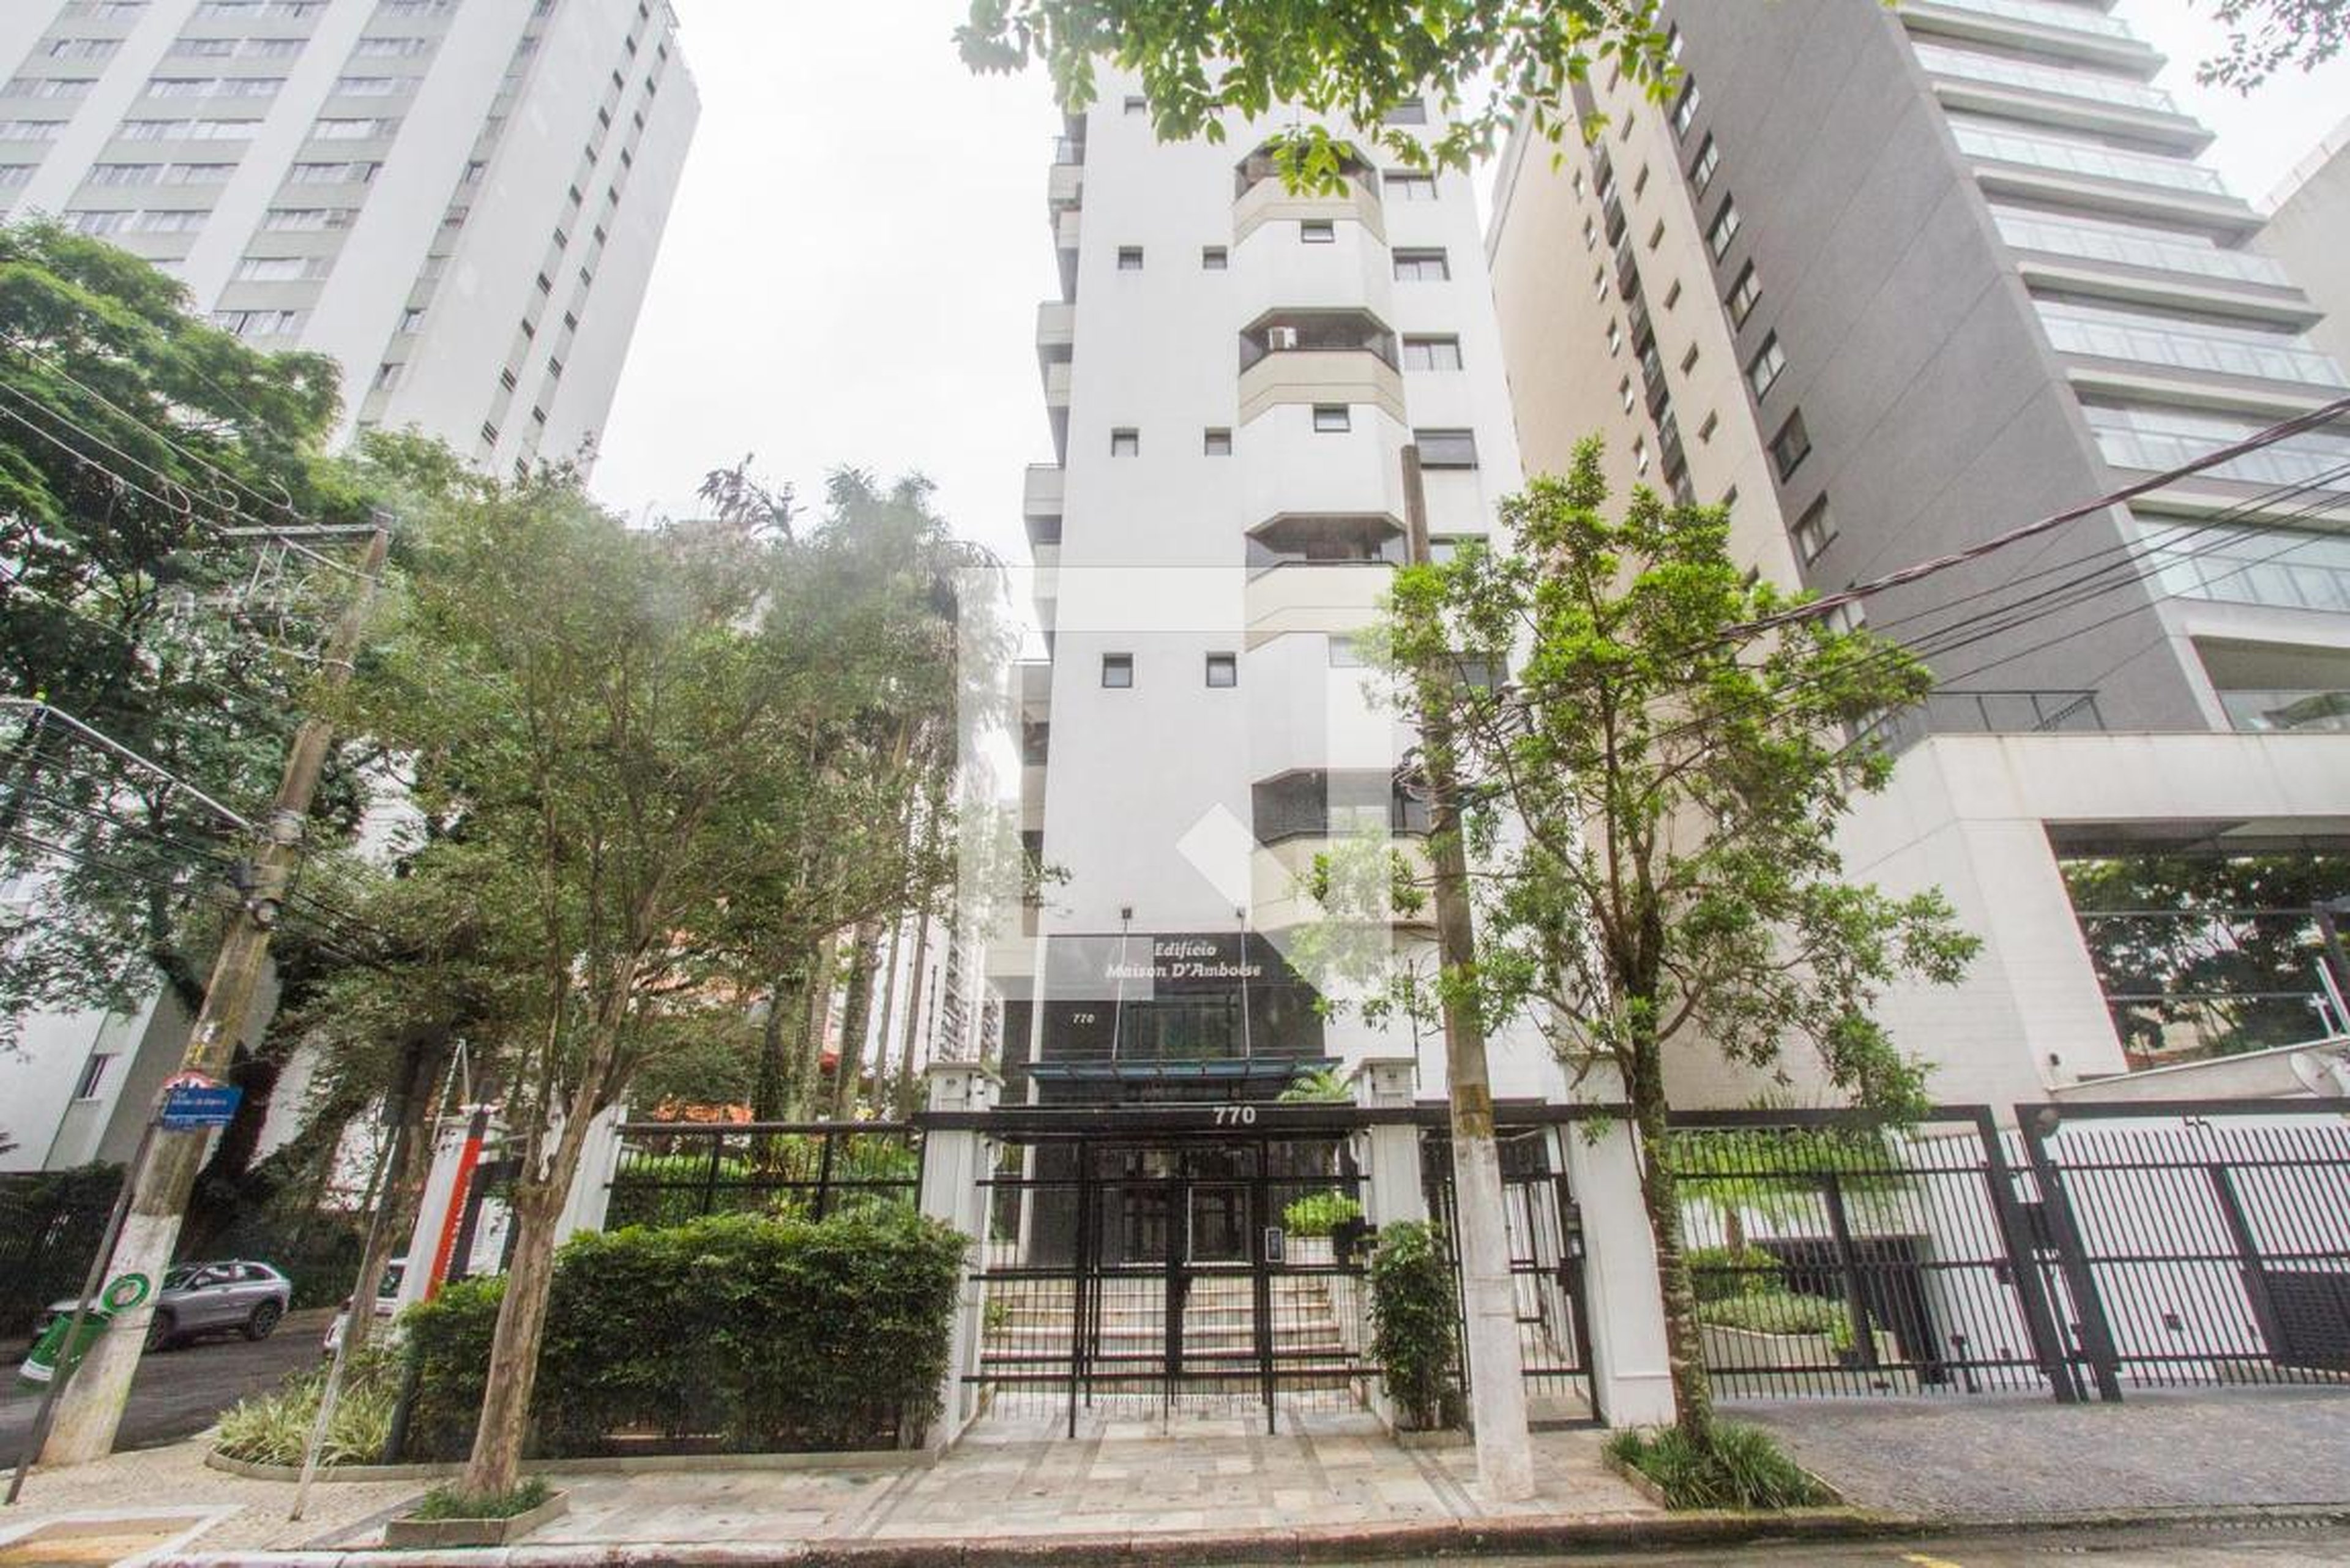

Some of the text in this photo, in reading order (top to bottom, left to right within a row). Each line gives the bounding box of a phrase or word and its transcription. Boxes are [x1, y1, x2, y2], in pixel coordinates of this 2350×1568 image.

[1105, 963, 1167, 978] Maison
[1073, 1013, 1095, 1023] 770
[1213, 1106, 1256, 1125] 770
